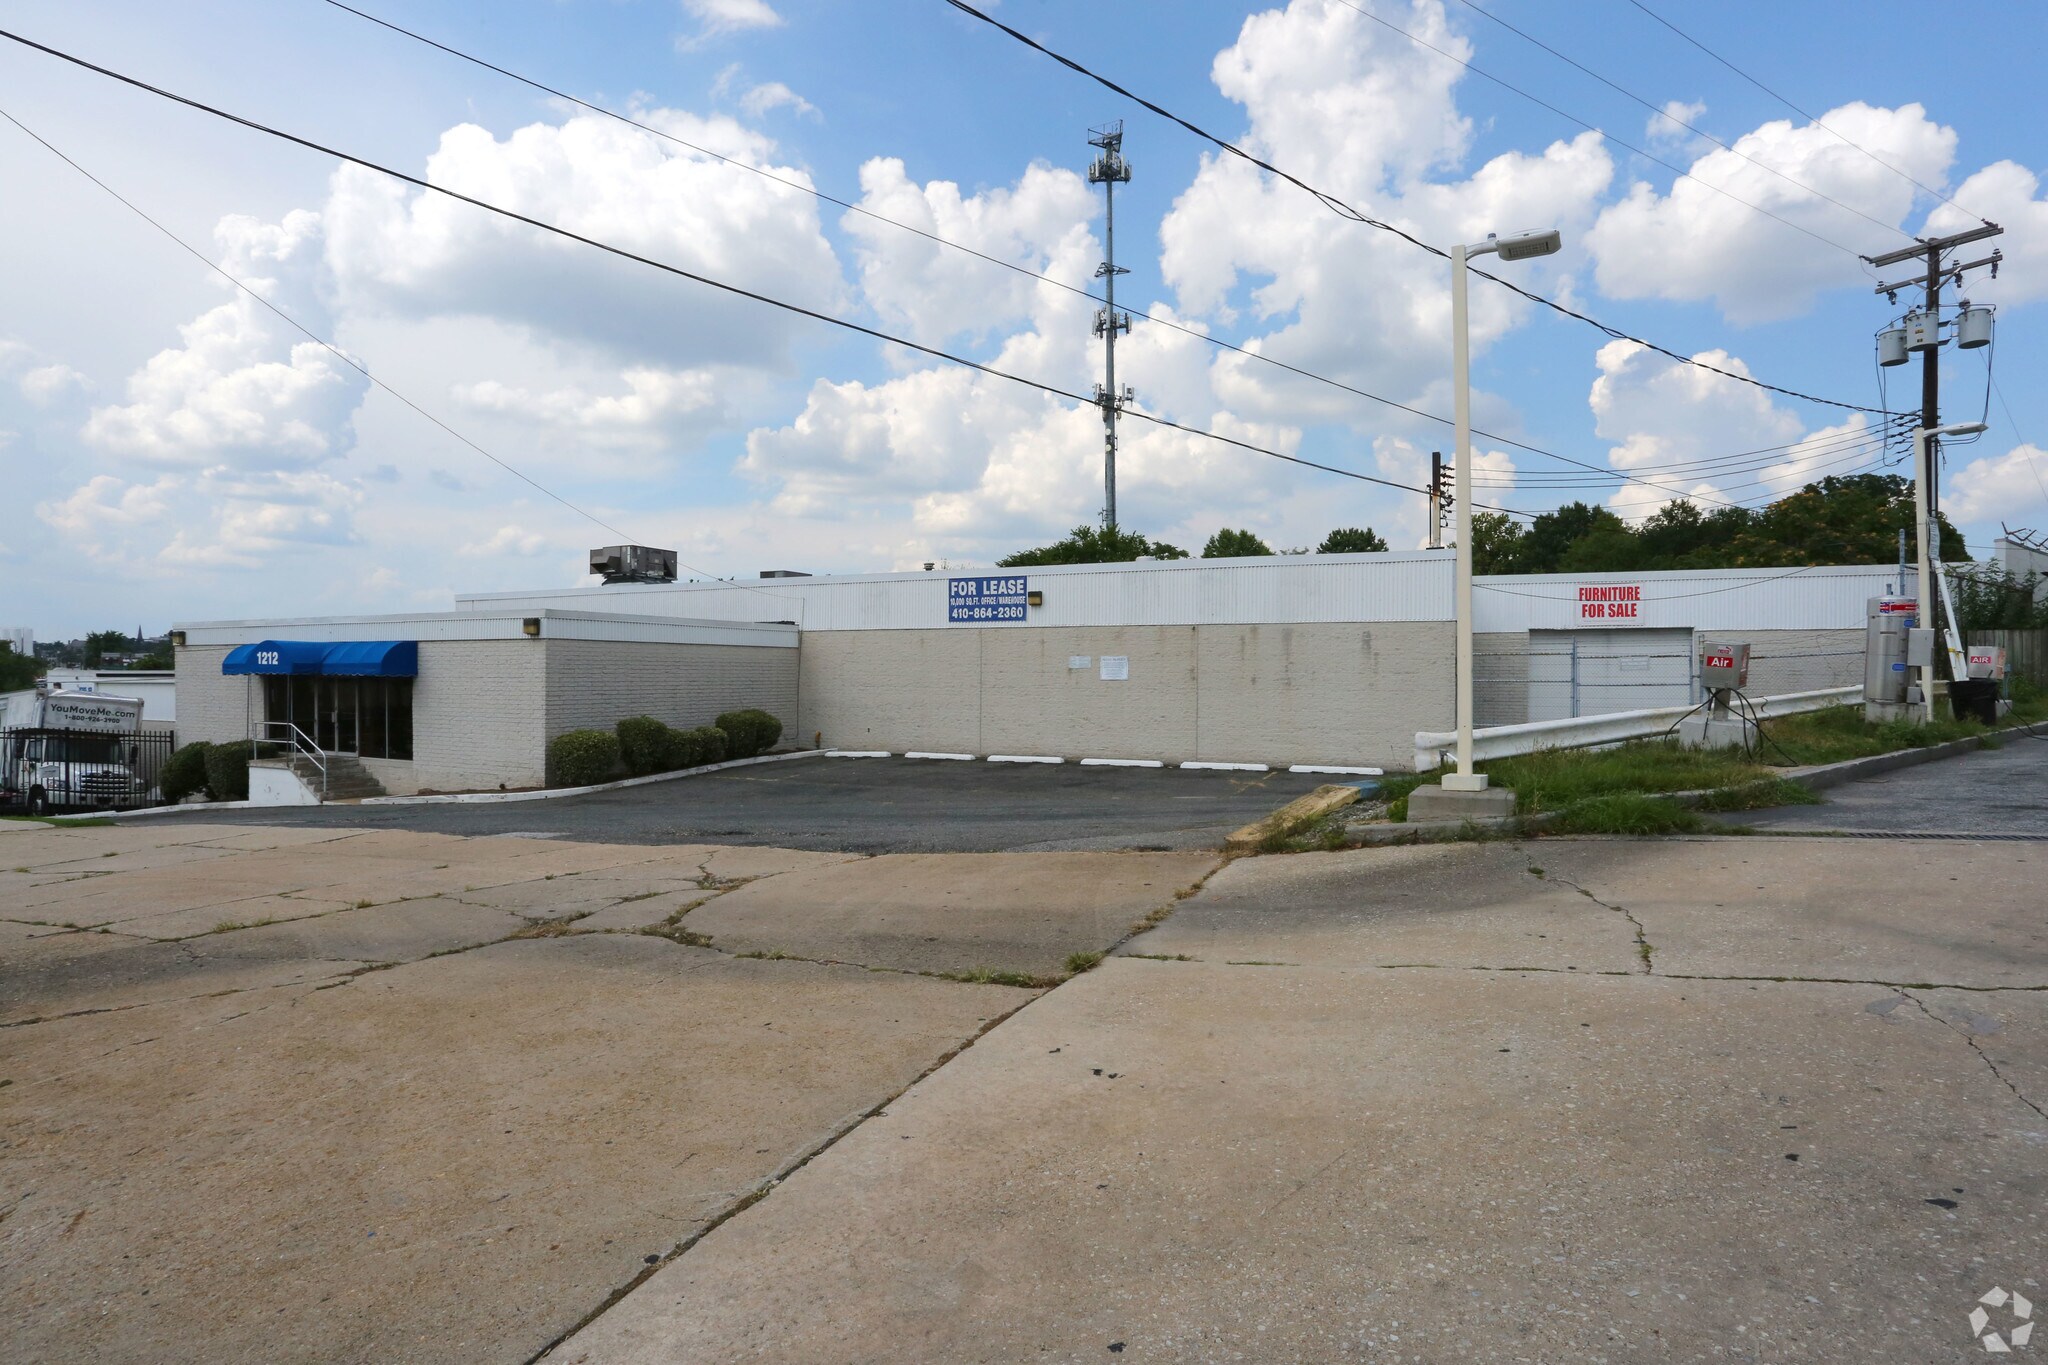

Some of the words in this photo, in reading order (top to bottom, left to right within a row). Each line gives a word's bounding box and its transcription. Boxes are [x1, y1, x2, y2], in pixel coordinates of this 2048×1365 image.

[951, 581, 977, 596] FOR
[983, 579, 1025, 595] LEASE
[1578, 586, 1641, 602] FURNITURE
[950, 597, 965, 607] 10,000
[952, 606, 1024, 619] 410-864-2360
[1582, 603, 1605, 618] FOR
[1608, 603, 1637, 618] SALE
[256, 651, 279, 665] 1212
[1711, 657, 1730, 667] Air
[50, 703, 136, 719] YouMoveMe.com
